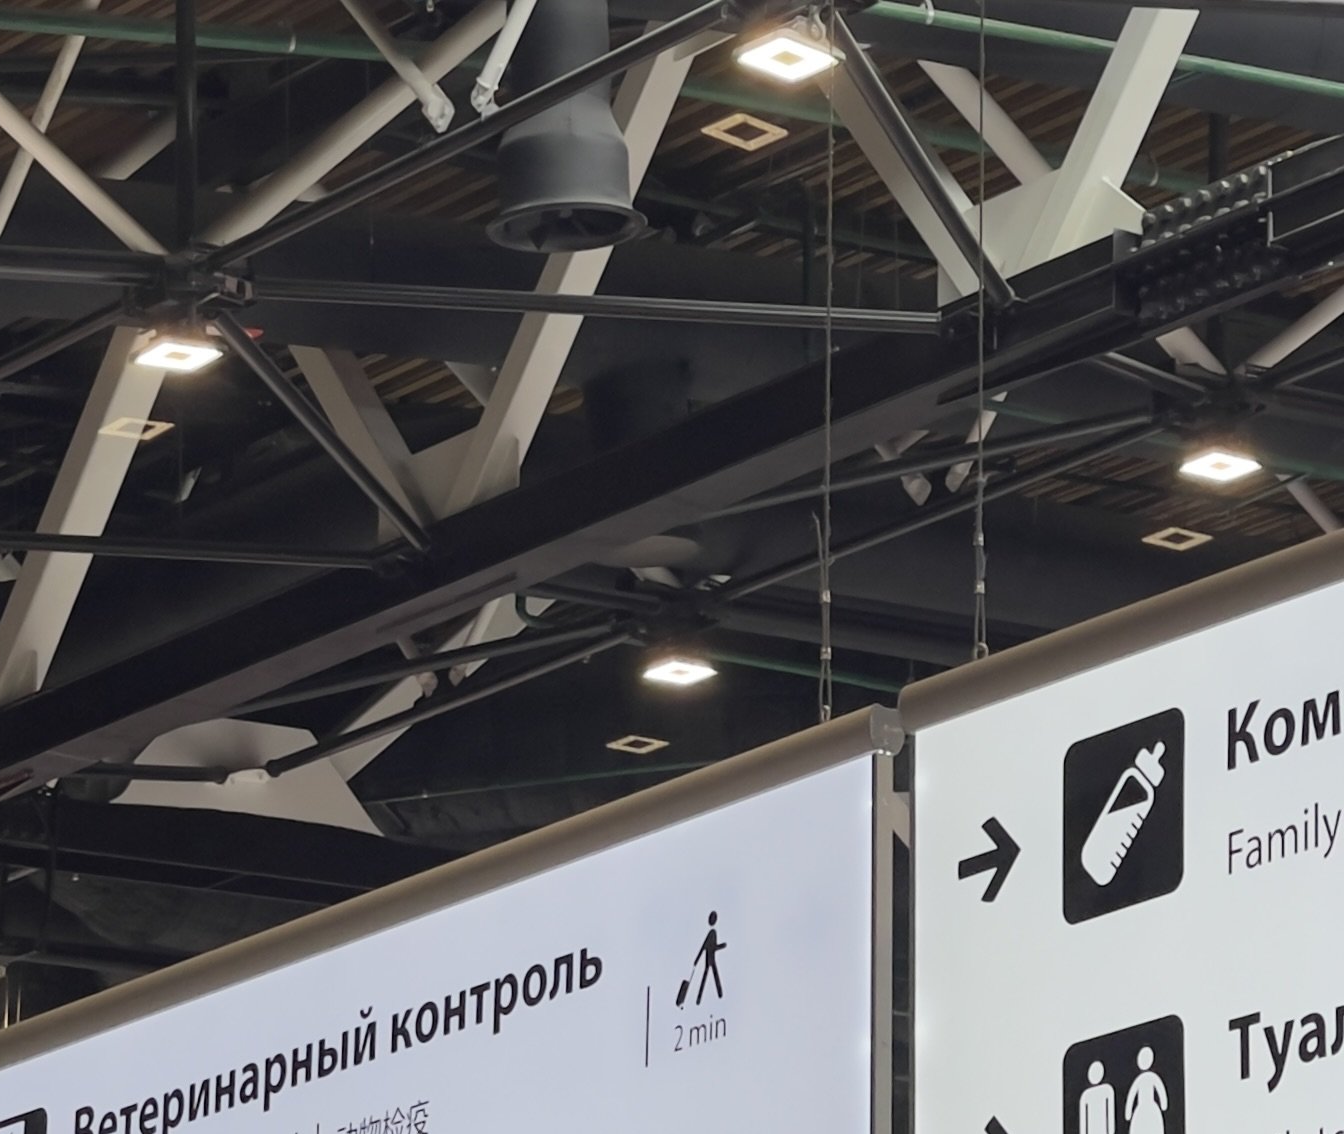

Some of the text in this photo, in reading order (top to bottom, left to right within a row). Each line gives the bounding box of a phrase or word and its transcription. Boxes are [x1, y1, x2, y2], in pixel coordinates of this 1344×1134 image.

[1229, 803, 1341, 874] Family
[391, 948, 602, 1053] контроль
[674, 1015, 726, 1051] 2 min
